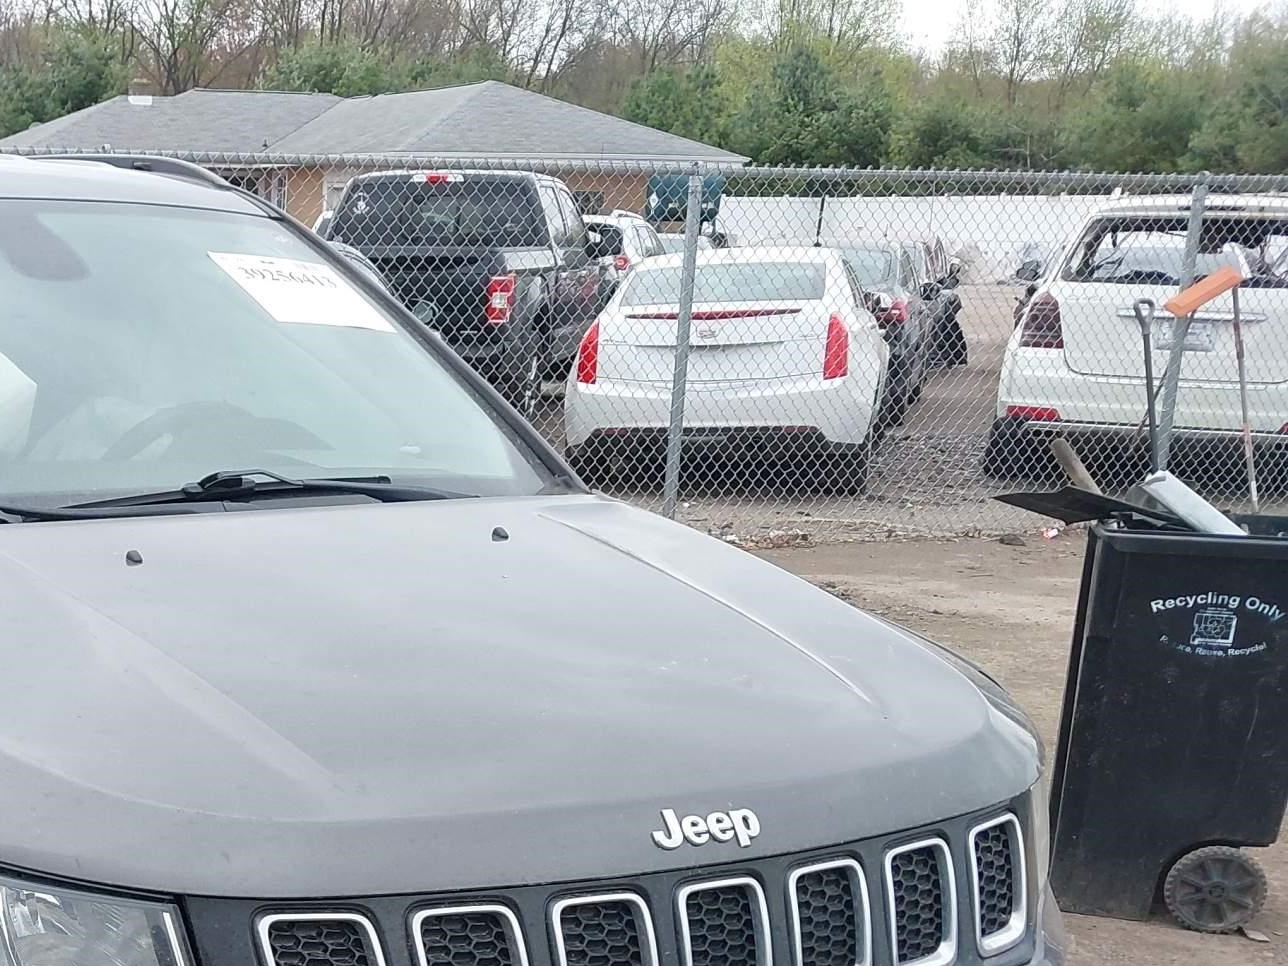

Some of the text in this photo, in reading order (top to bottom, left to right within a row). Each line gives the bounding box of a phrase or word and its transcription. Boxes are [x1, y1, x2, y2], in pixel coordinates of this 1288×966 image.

[1150, 591, 1286, 622] Recycling Only
[651, 808, 761, 850] Jeep
